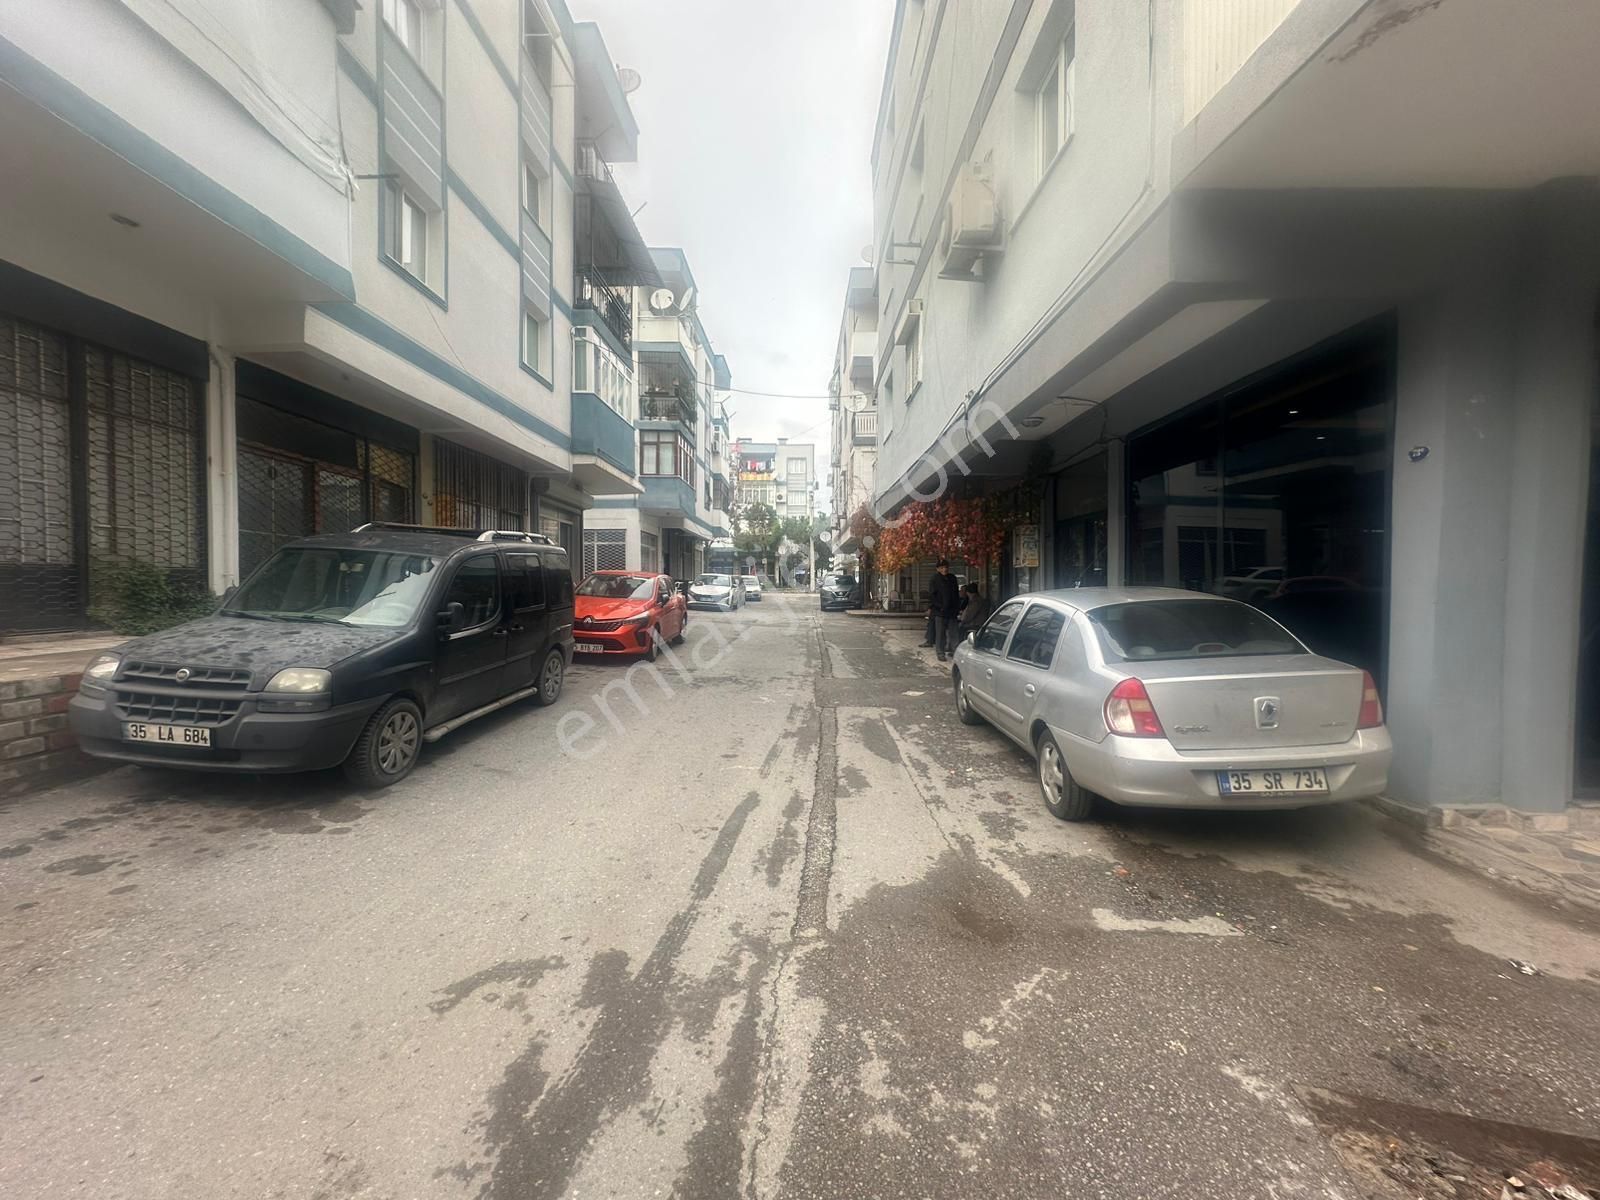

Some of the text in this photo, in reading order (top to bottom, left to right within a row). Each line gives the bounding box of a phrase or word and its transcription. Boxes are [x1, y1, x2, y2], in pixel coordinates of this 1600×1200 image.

[131, 724, 208, 744] 35 LA 684
[1231, 770, 1323, 790] 35 SR 734
